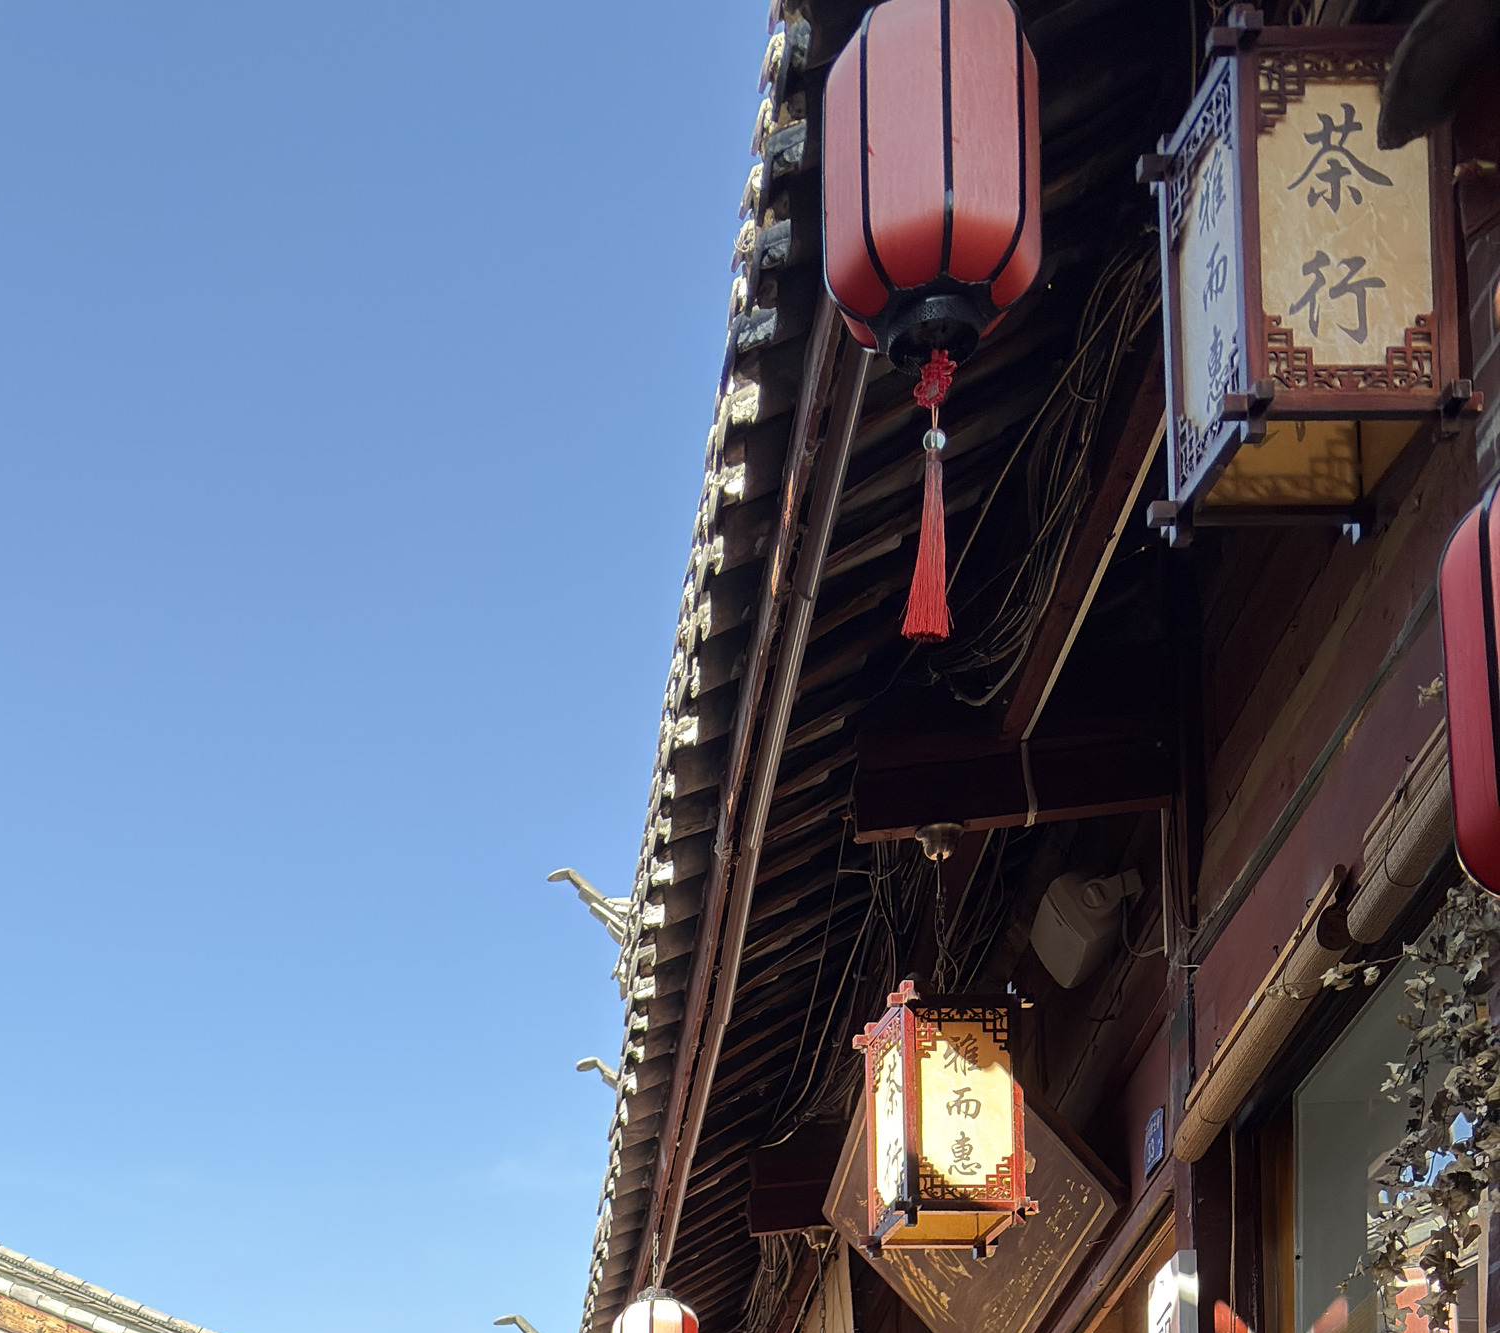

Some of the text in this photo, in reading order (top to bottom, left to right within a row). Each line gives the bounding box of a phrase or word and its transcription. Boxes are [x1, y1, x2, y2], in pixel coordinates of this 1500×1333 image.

[1200, 147, 1228, 413] 雅而惠
[1288, 102, 1393, 344] 茶行
[944, 1033, 982, 1176] 雅而惠
